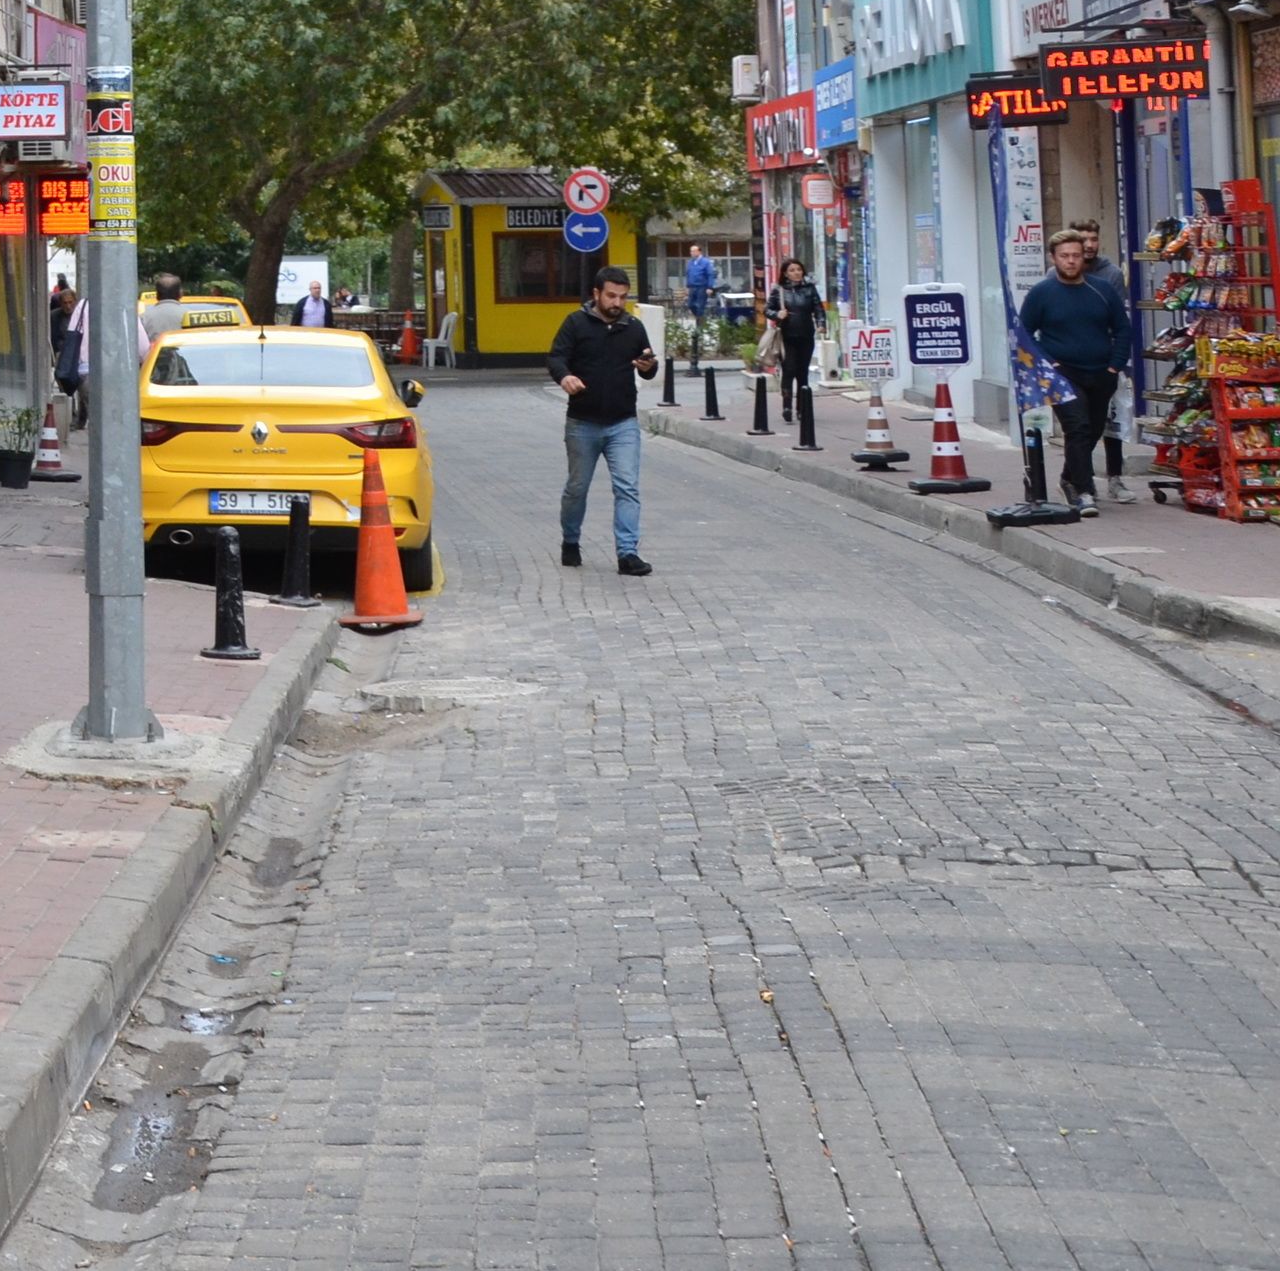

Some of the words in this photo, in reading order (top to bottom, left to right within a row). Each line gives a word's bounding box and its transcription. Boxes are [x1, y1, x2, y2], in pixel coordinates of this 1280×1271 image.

[0, 90, 59, 107] KÖFTE
[2, 111, 56, 128] PİYAZ
[507, 207, 559, 227] BELEDİYE
[915, 300, 956, 314] ERGÜL
[191, 310, 232, 325] TAKSİ
[911, 316, 961, 330] İLETİŞİM
[851, 328, 892, 350] NETA
[851, 349, 893, 362] ELEKTRİK
[218, 493, 238, 508] 59
[248, 493, 258, 508] T
[267, 493, 297, 509] 518
